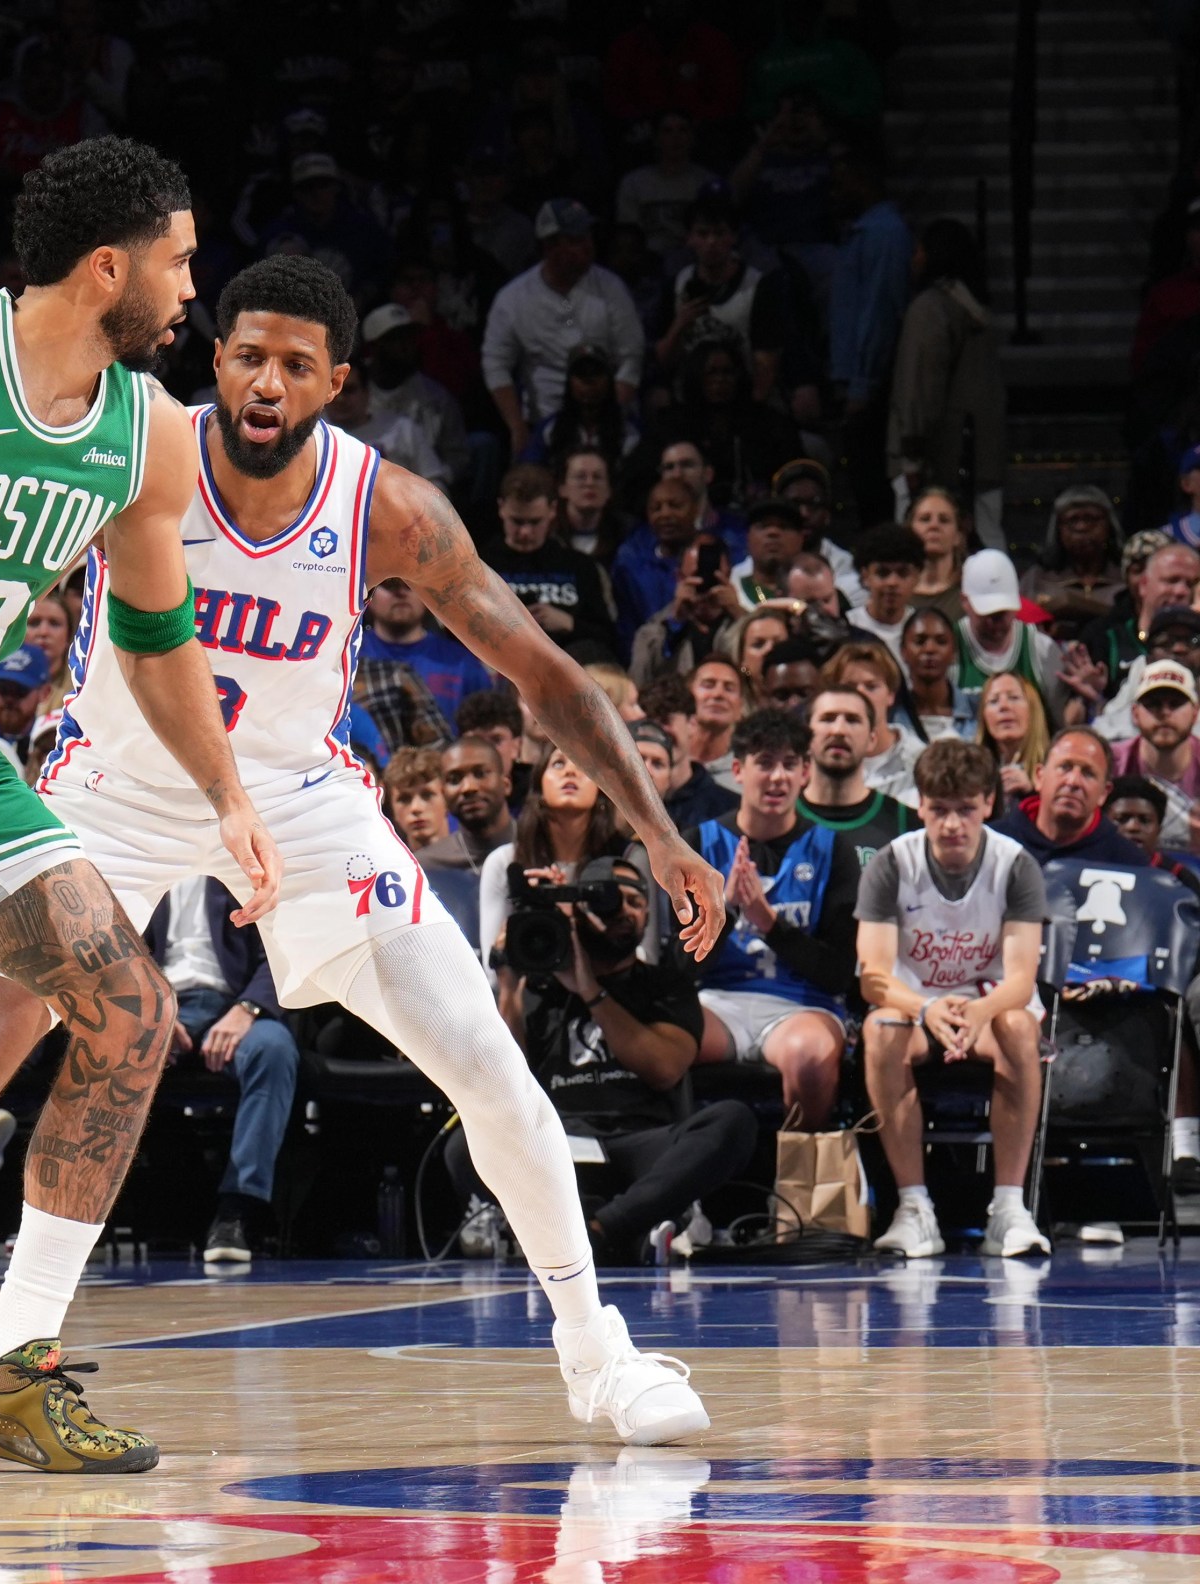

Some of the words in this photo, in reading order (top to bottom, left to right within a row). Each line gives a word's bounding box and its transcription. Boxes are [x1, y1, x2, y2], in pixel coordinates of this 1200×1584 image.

[82, 446, 126, 468] Amica
[292, 561, 347, 574] crypto.com
[193, 587, 333, 662] HILA
[346, 870, 407, 919] 76
[908, 929, 1000, 971] Brotherly
[921, 960, 968, 988] Love
